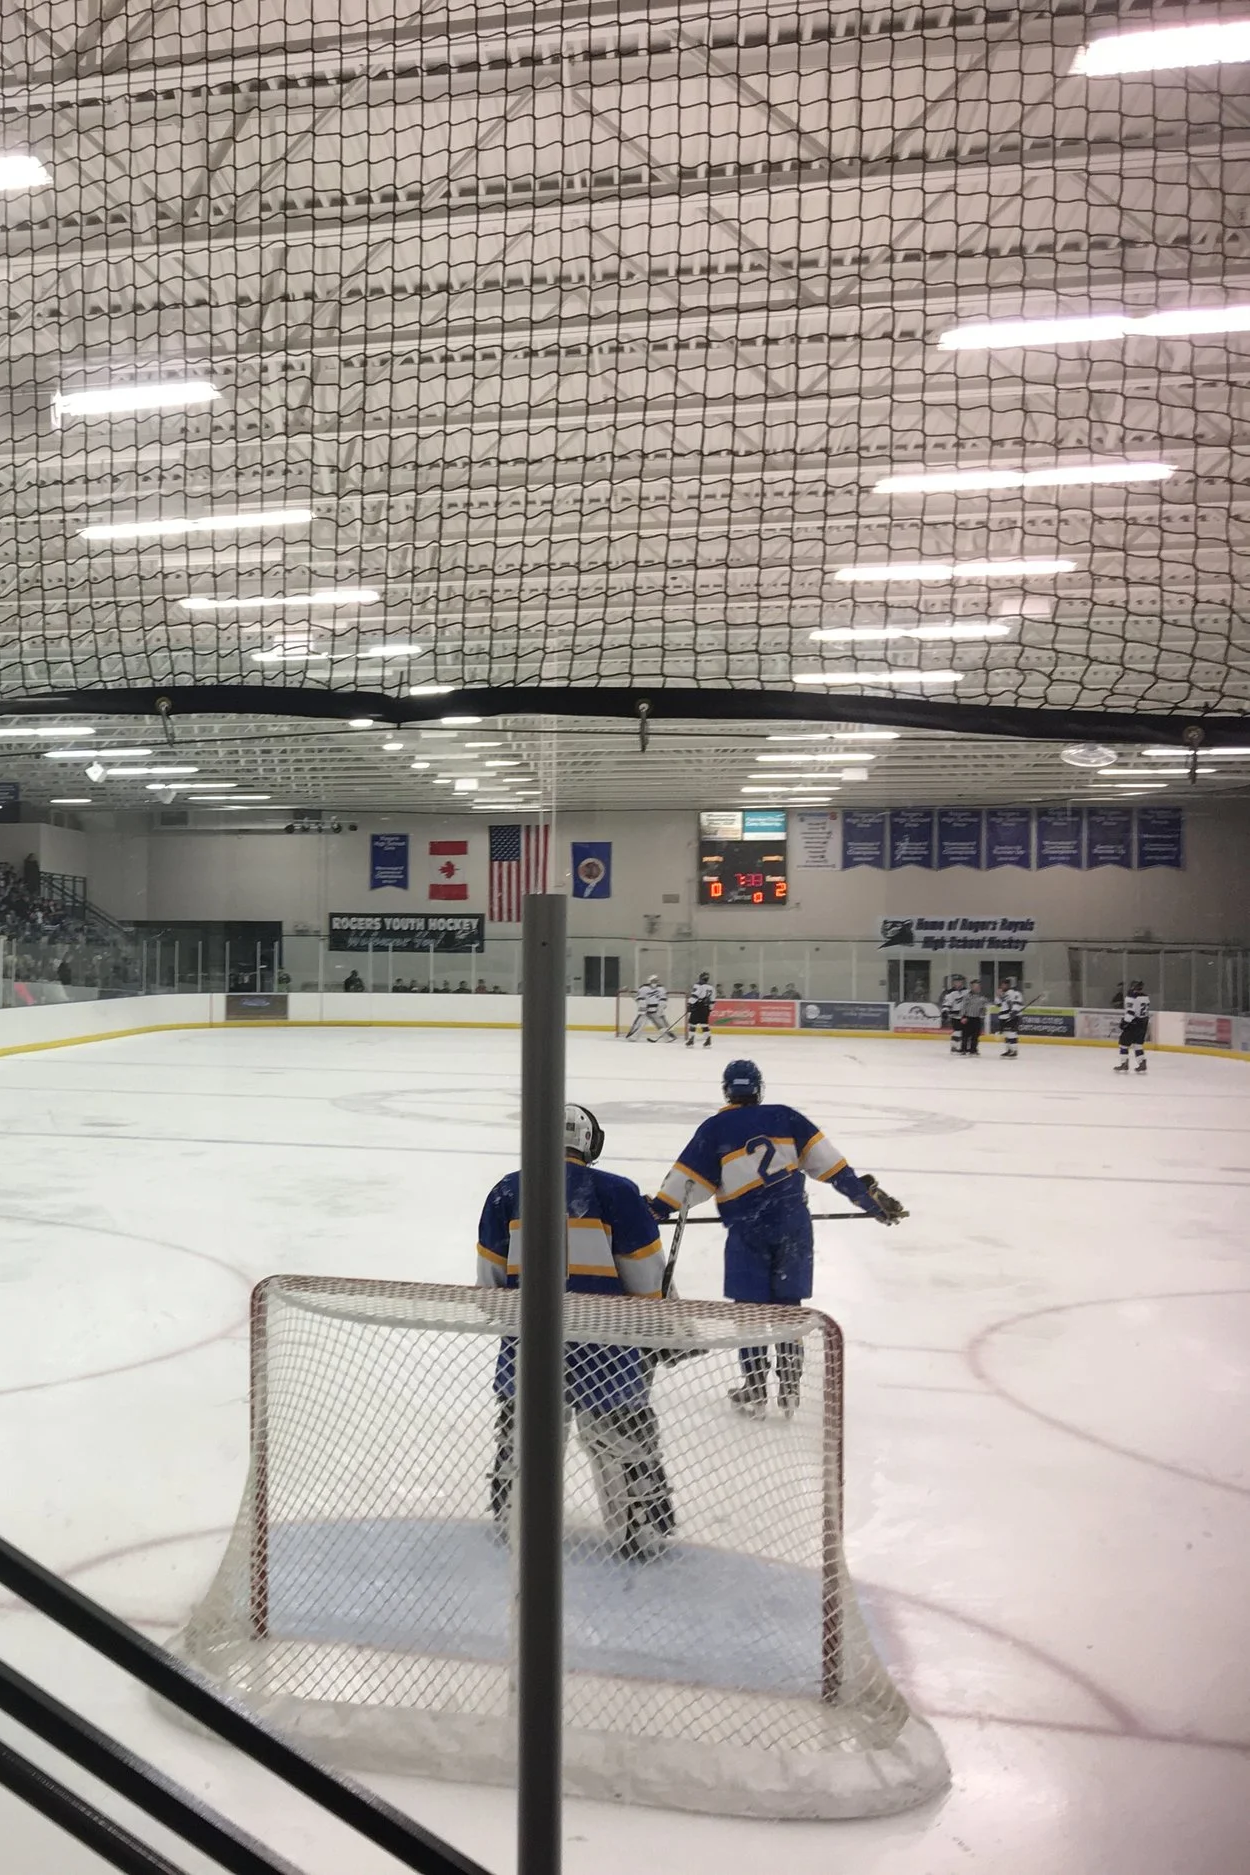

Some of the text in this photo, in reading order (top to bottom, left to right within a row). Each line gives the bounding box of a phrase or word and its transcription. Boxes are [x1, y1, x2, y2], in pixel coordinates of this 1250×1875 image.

[711, 882, 722, 897] 0
[775, 882, 787, 897] 2
[331, 917, 479, 931] ROGERS YOUTH HOCKEY
[915, 918, 945, 931] Home
[947, 918, 960, 931] of
[959, 918, 998, 933] Rogers
[745, 1135, 792, 1188] 2
